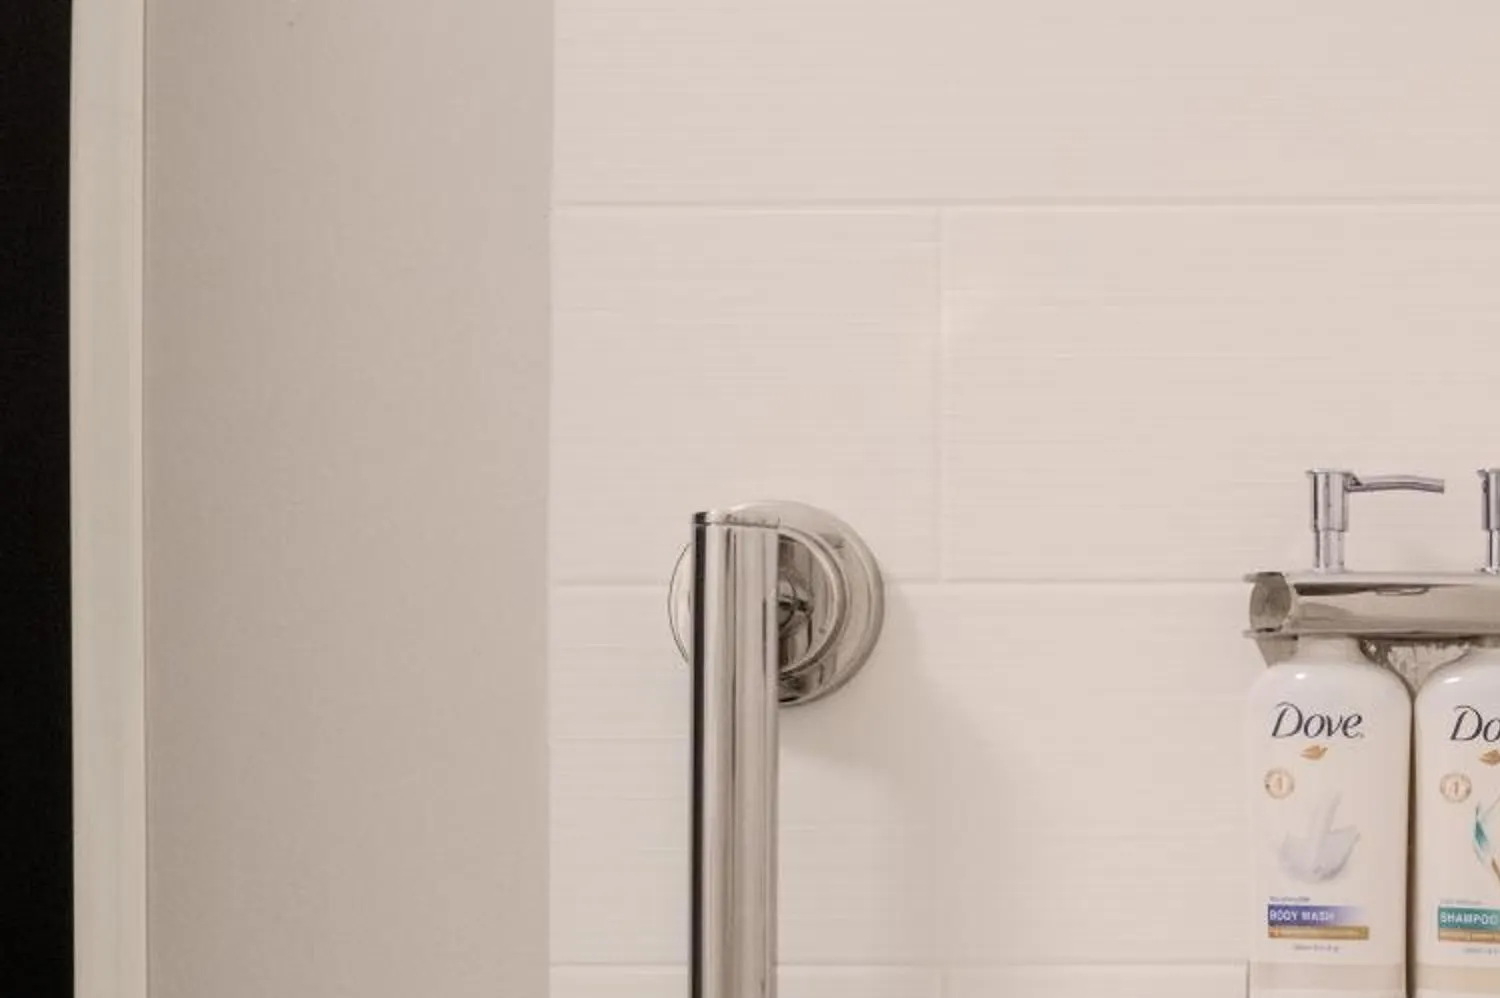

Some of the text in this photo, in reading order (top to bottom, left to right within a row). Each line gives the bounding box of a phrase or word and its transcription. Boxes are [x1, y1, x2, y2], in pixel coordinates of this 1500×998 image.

[1271, 701, 1364, 738] Dove
[1269, 909, 1335, 922] BODY WASH
[1440, 911, 1498, 926] SHAMPOO
